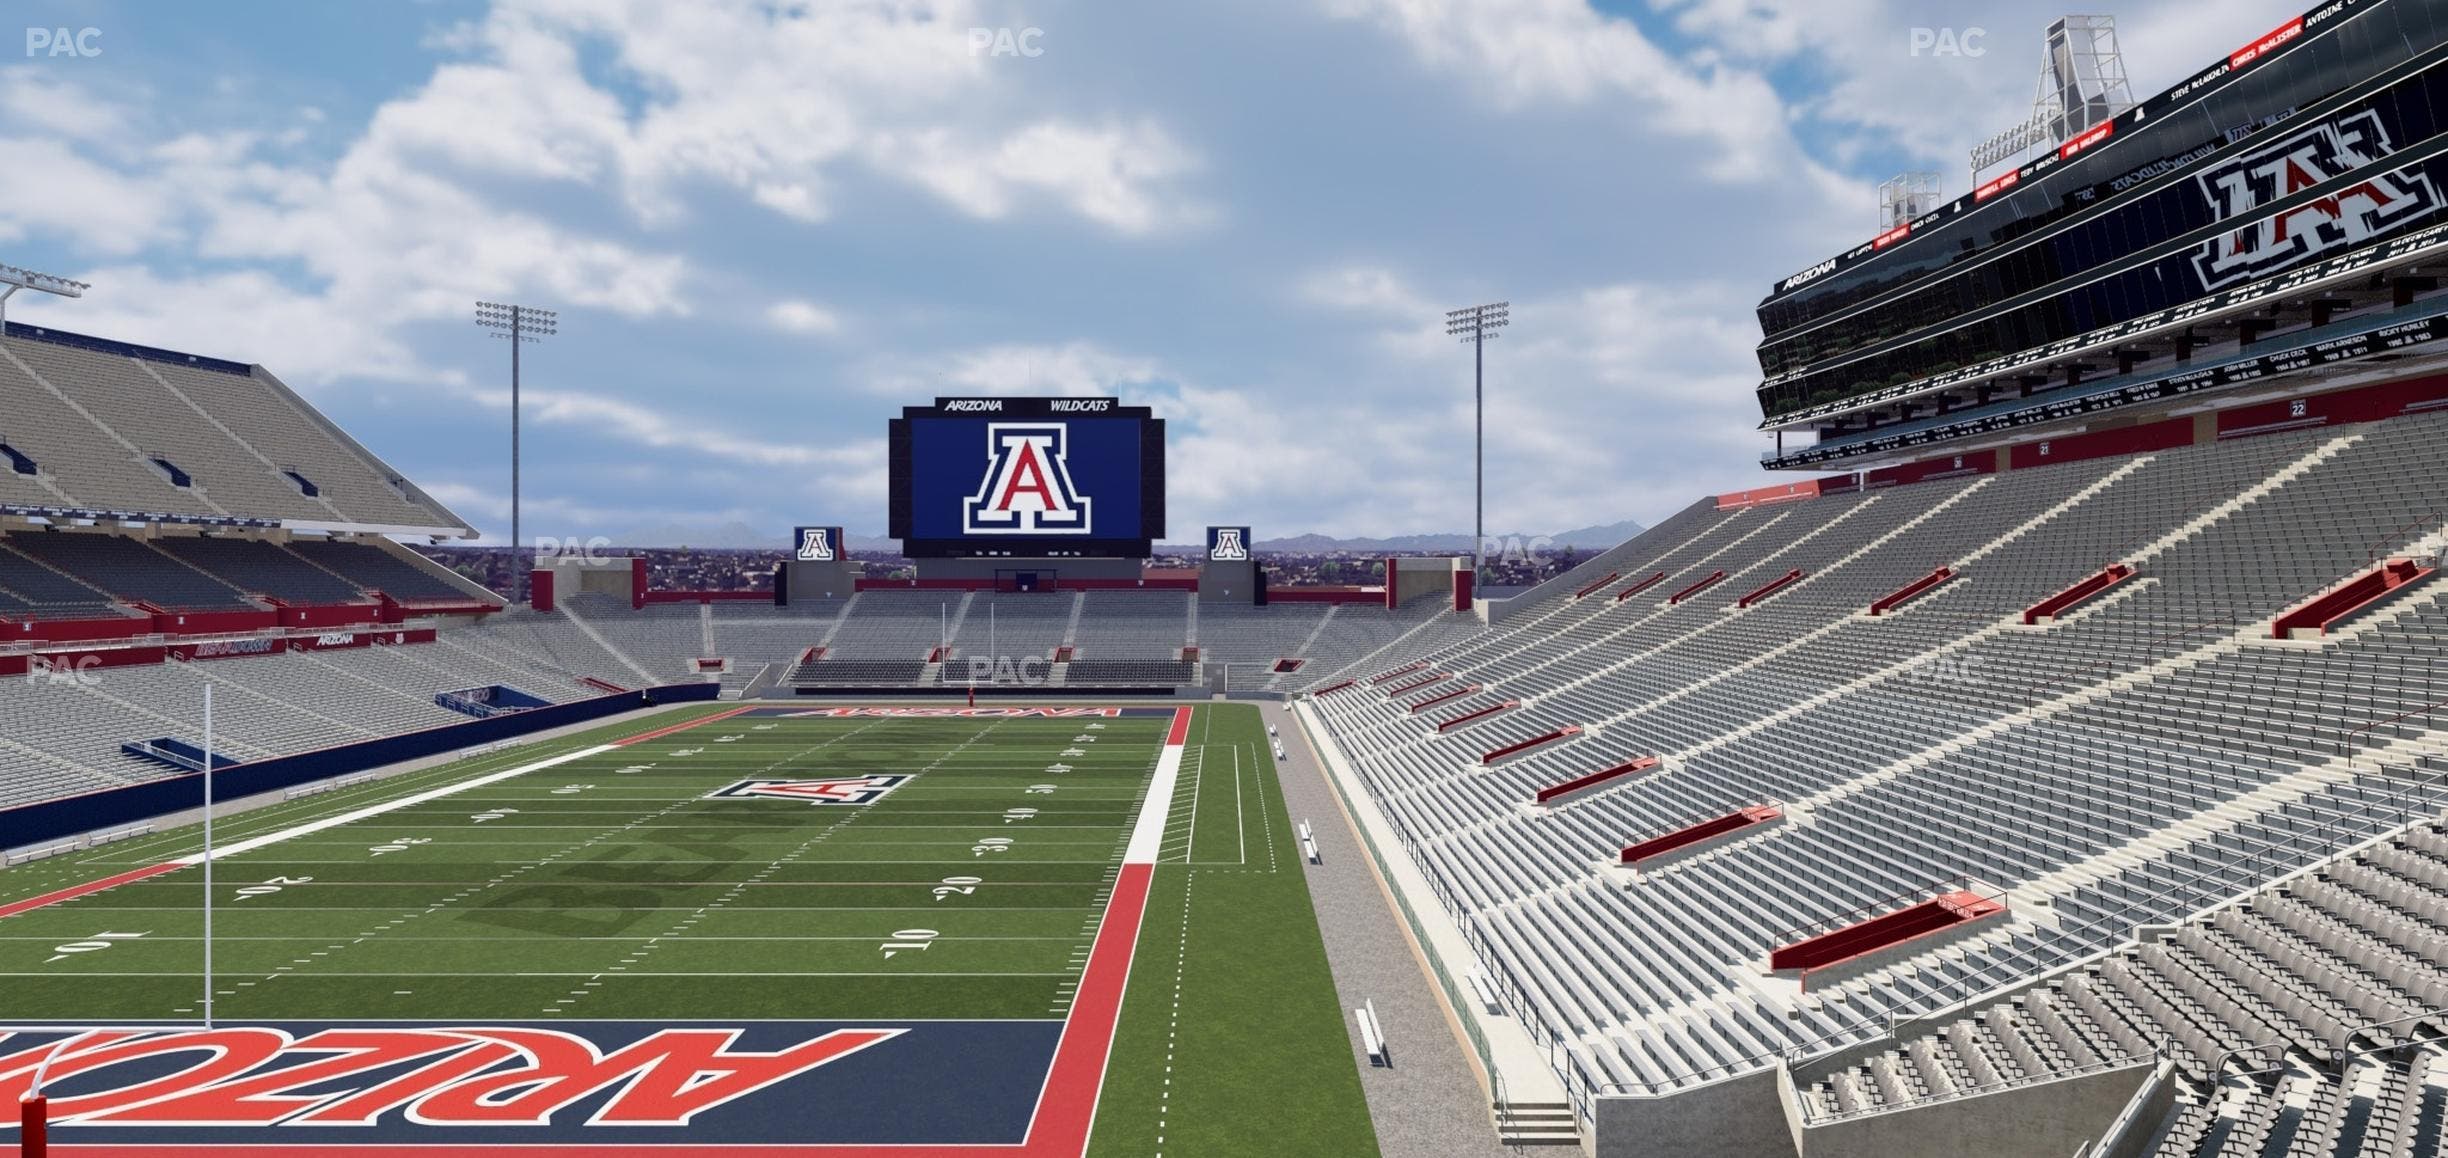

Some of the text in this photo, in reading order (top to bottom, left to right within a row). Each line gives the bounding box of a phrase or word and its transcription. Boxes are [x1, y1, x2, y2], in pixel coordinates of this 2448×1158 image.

[2170, 84, 2190, 101] STEVE
[1782, 258, 1836, 291] ARIZONA
[944, 400, 1110, 411] ARIZONA WILDCATS
[2292, 404, 2305, 417] 22
[963, 422, 1092, 535] A
[797, 529, 834, 561] A
[1211, 529, 1248, 561] A
[316, 633, 354, 646] ARIZONA
[702, 774, 918, 806] A
[1003, 808, 1039, 820] 40
[971, 837, 1015, 852] 30
[236, 876, 314, 895] 20
[932, 876, 983, 895] 20
[54, 930, 153, 953] 10
[879, 928, 940, 951] 10
